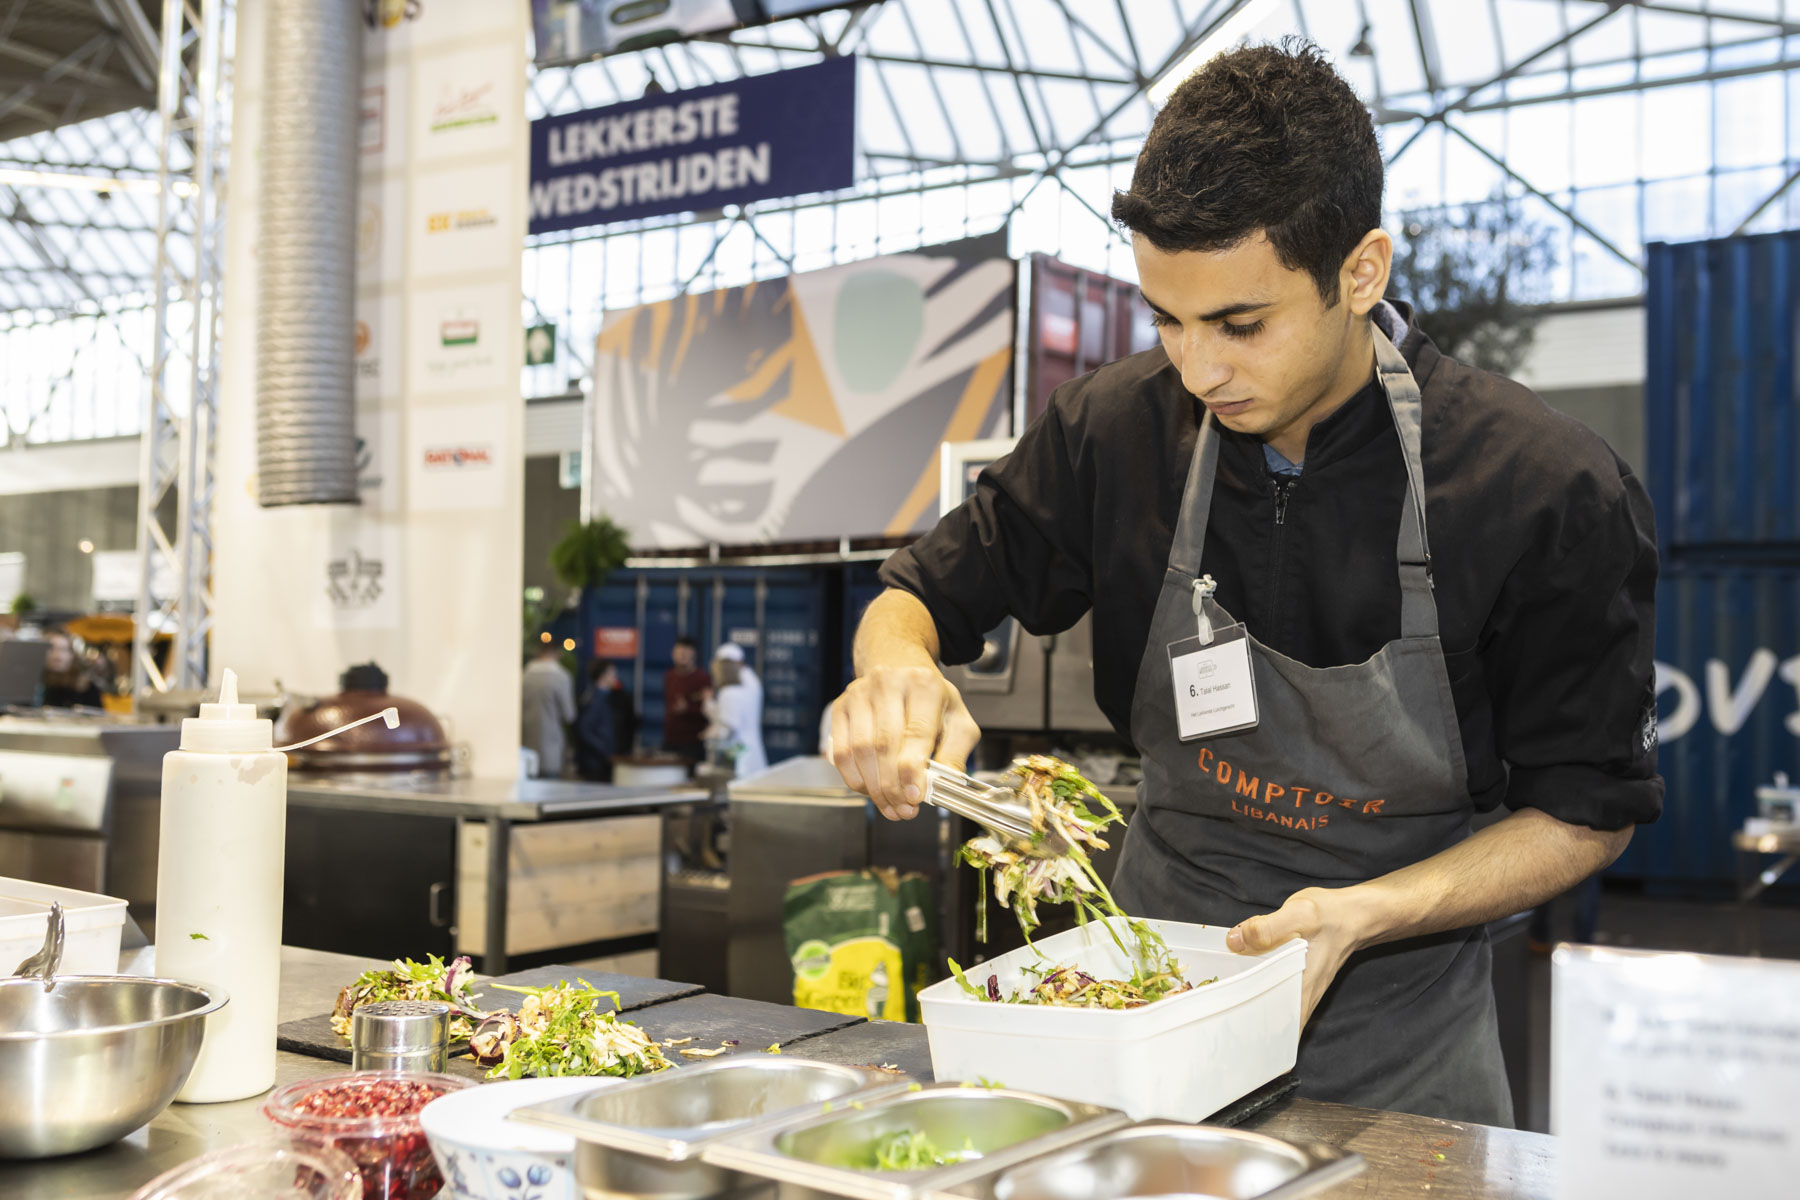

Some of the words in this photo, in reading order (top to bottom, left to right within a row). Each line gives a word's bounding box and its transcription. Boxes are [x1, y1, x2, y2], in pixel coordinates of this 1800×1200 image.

[547, 92, 740, 167] LEKKERSTE
[529, 141, 771, 221] WEDSTRIJDEN
[1189, 684, 1199, 697] 6.
[1198, 747, 1385, 814] COMPTOIR
[1231, 800, 1330, 831] LIBANAIS
